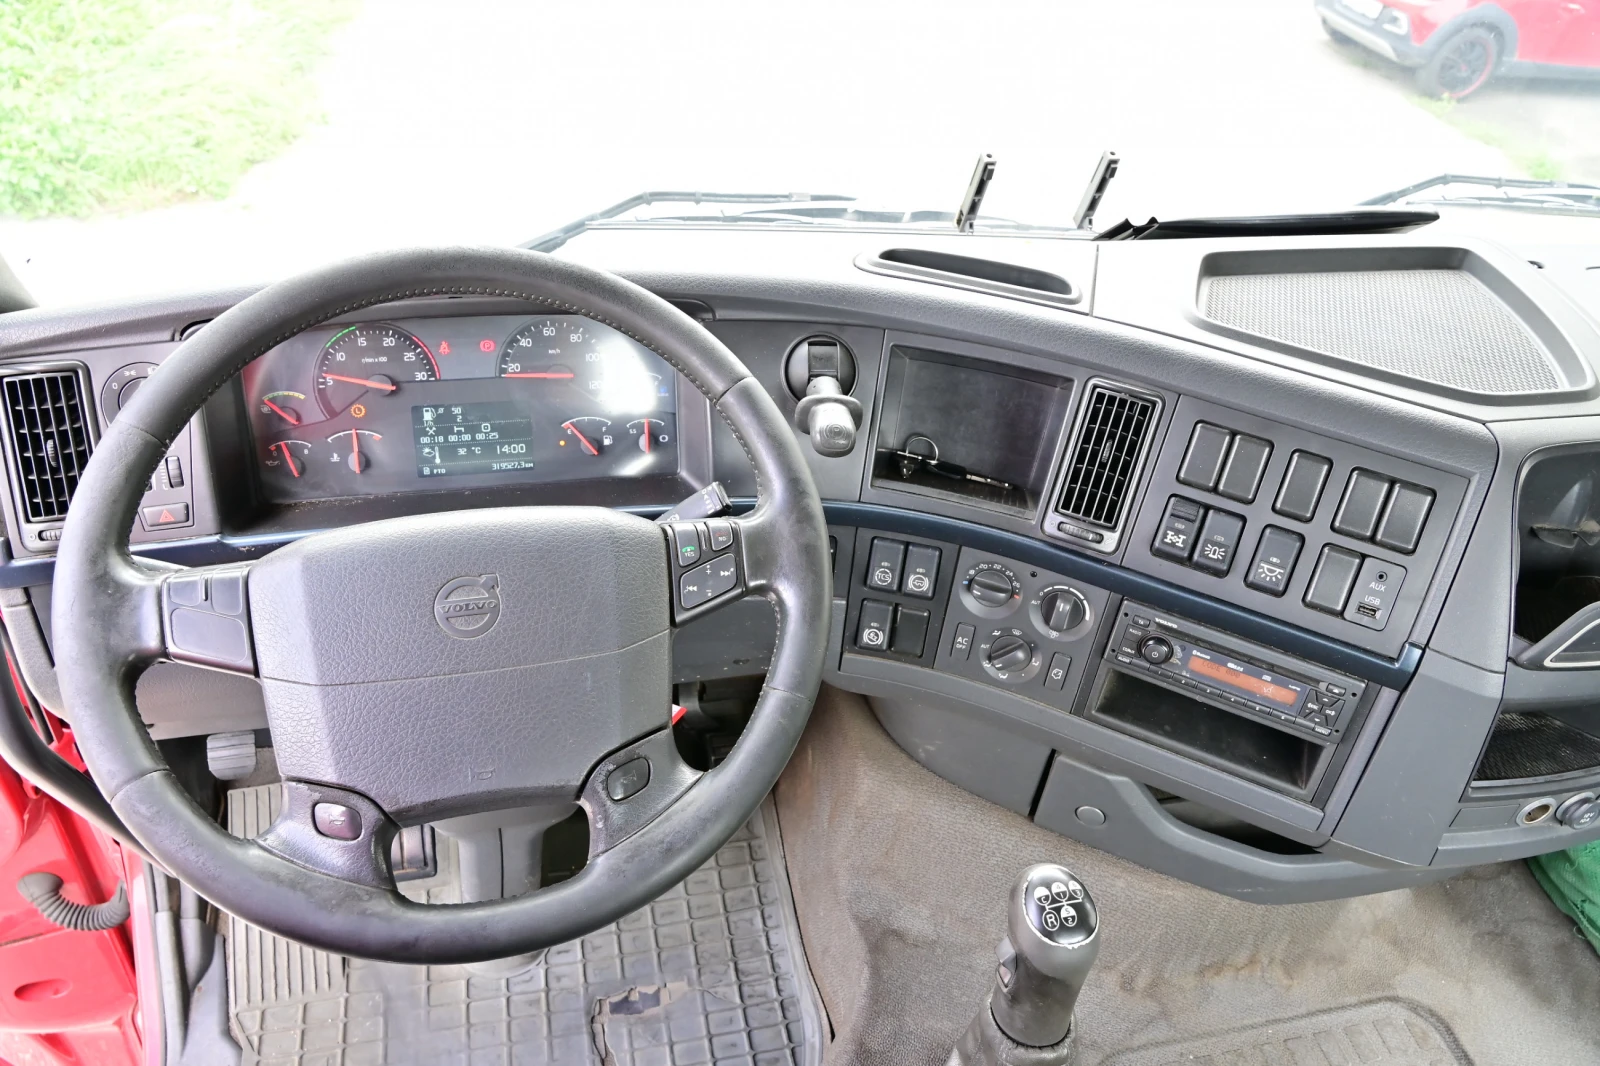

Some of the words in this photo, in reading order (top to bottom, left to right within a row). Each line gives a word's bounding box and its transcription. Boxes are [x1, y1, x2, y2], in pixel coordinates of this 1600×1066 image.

[543, 327, 556, 336] 60
[357, 338, 367, 346] 15
[383, 338, 395, 346] 20
[570, 333, 582, 342] 80
[519, 338, 532, 347] 40
[336, 352, 346, 361] 10
[403, 352, 415, 361] 25
[585, 353, 600, 362] 100
[508, 363, 520, 372] 20
[414, 372, 427, 381] 30
[326, 377, 334, 386] 5
[420, 435, 444, 444] 00:18
[448, 433, 471, 442] 00:00
[475, 432, 499, 440] 00:25
[497, 444, 526, 454] 14:00
[1369, 581, 1387, 592] AUX
[1364, 595, 1381, 605] USB
[436, 600, 498, 614] VOLVO
[956, 636, 969, 645] AC
[1315, 727, 1331, 735] MENU
[1041, 896, 1047, 904] C
[1046, 913, 1057, 927] R
[1067, 917, 1073, 925] 2
